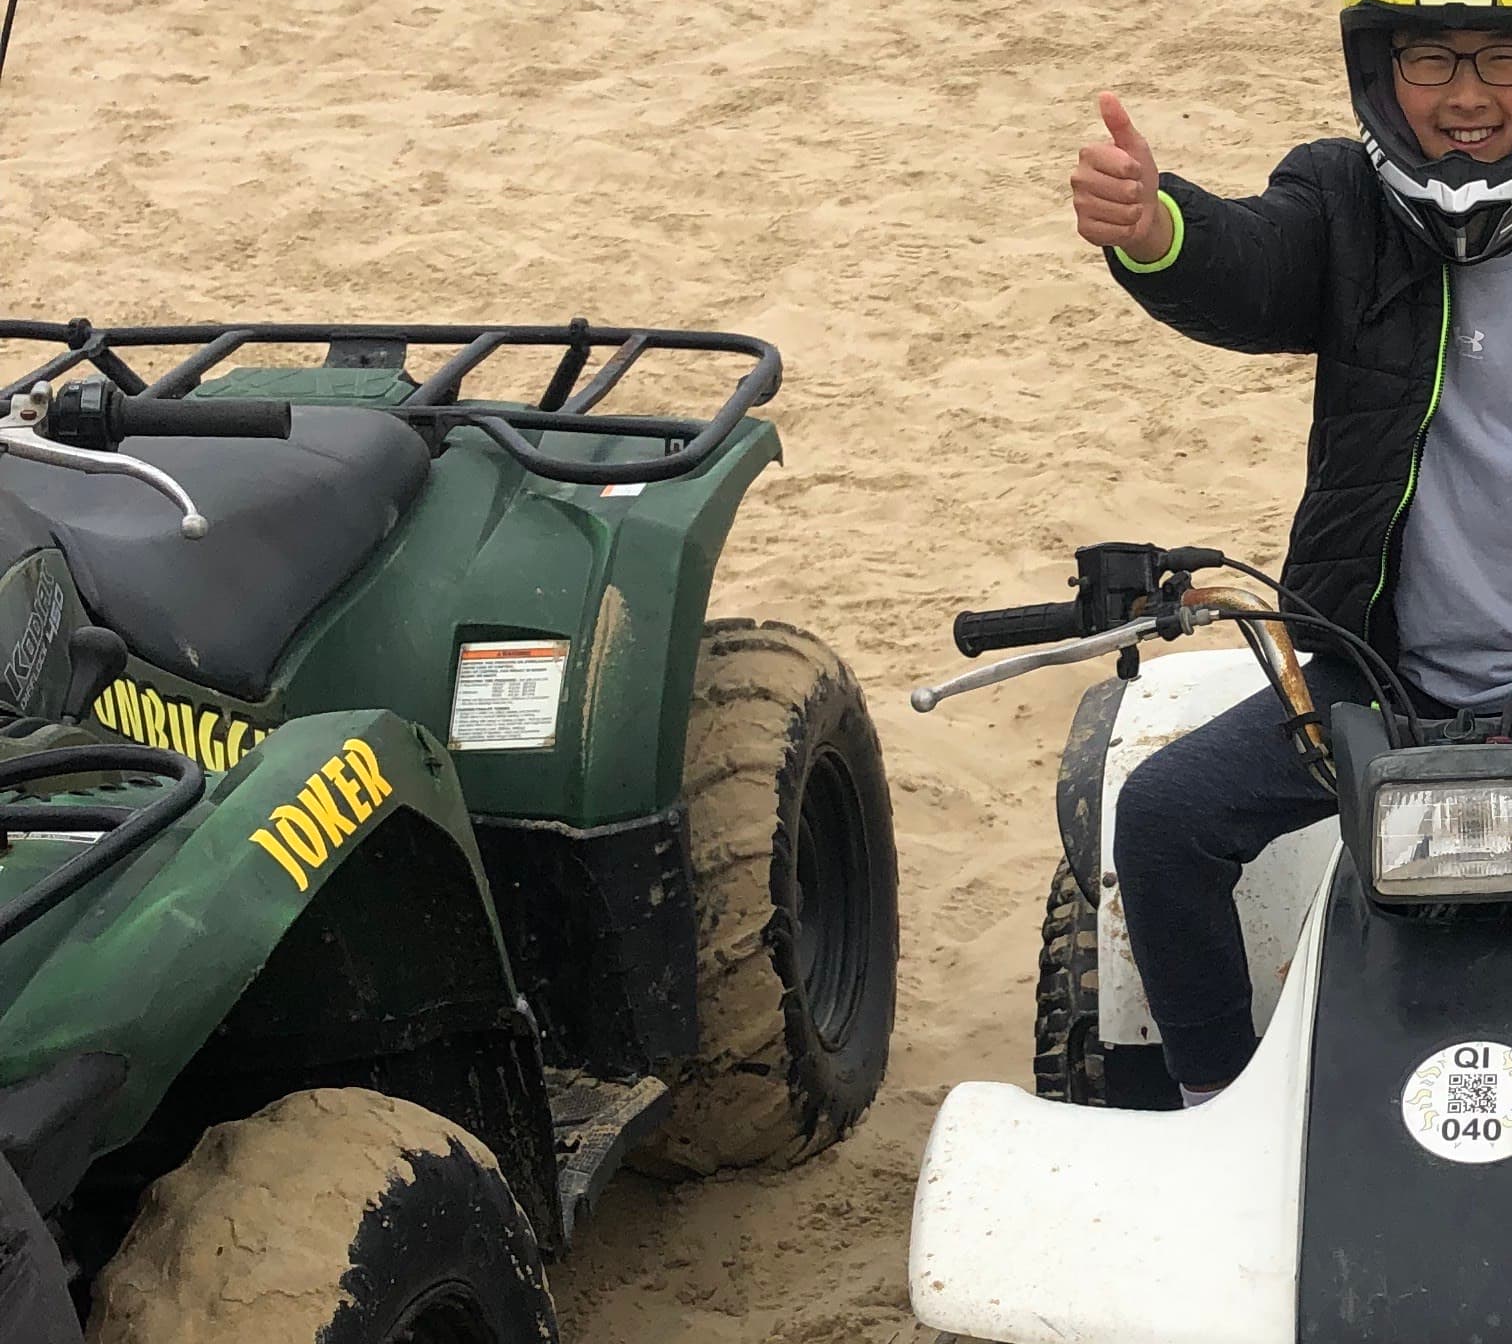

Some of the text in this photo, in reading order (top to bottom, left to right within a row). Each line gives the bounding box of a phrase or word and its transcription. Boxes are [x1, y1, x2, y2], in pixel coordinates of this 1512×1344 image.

[248, 738, 393, 892] JOKER
[1454, 1047, 1490, 1069] QI
[1441, 1118, 1502, 1141] 040
